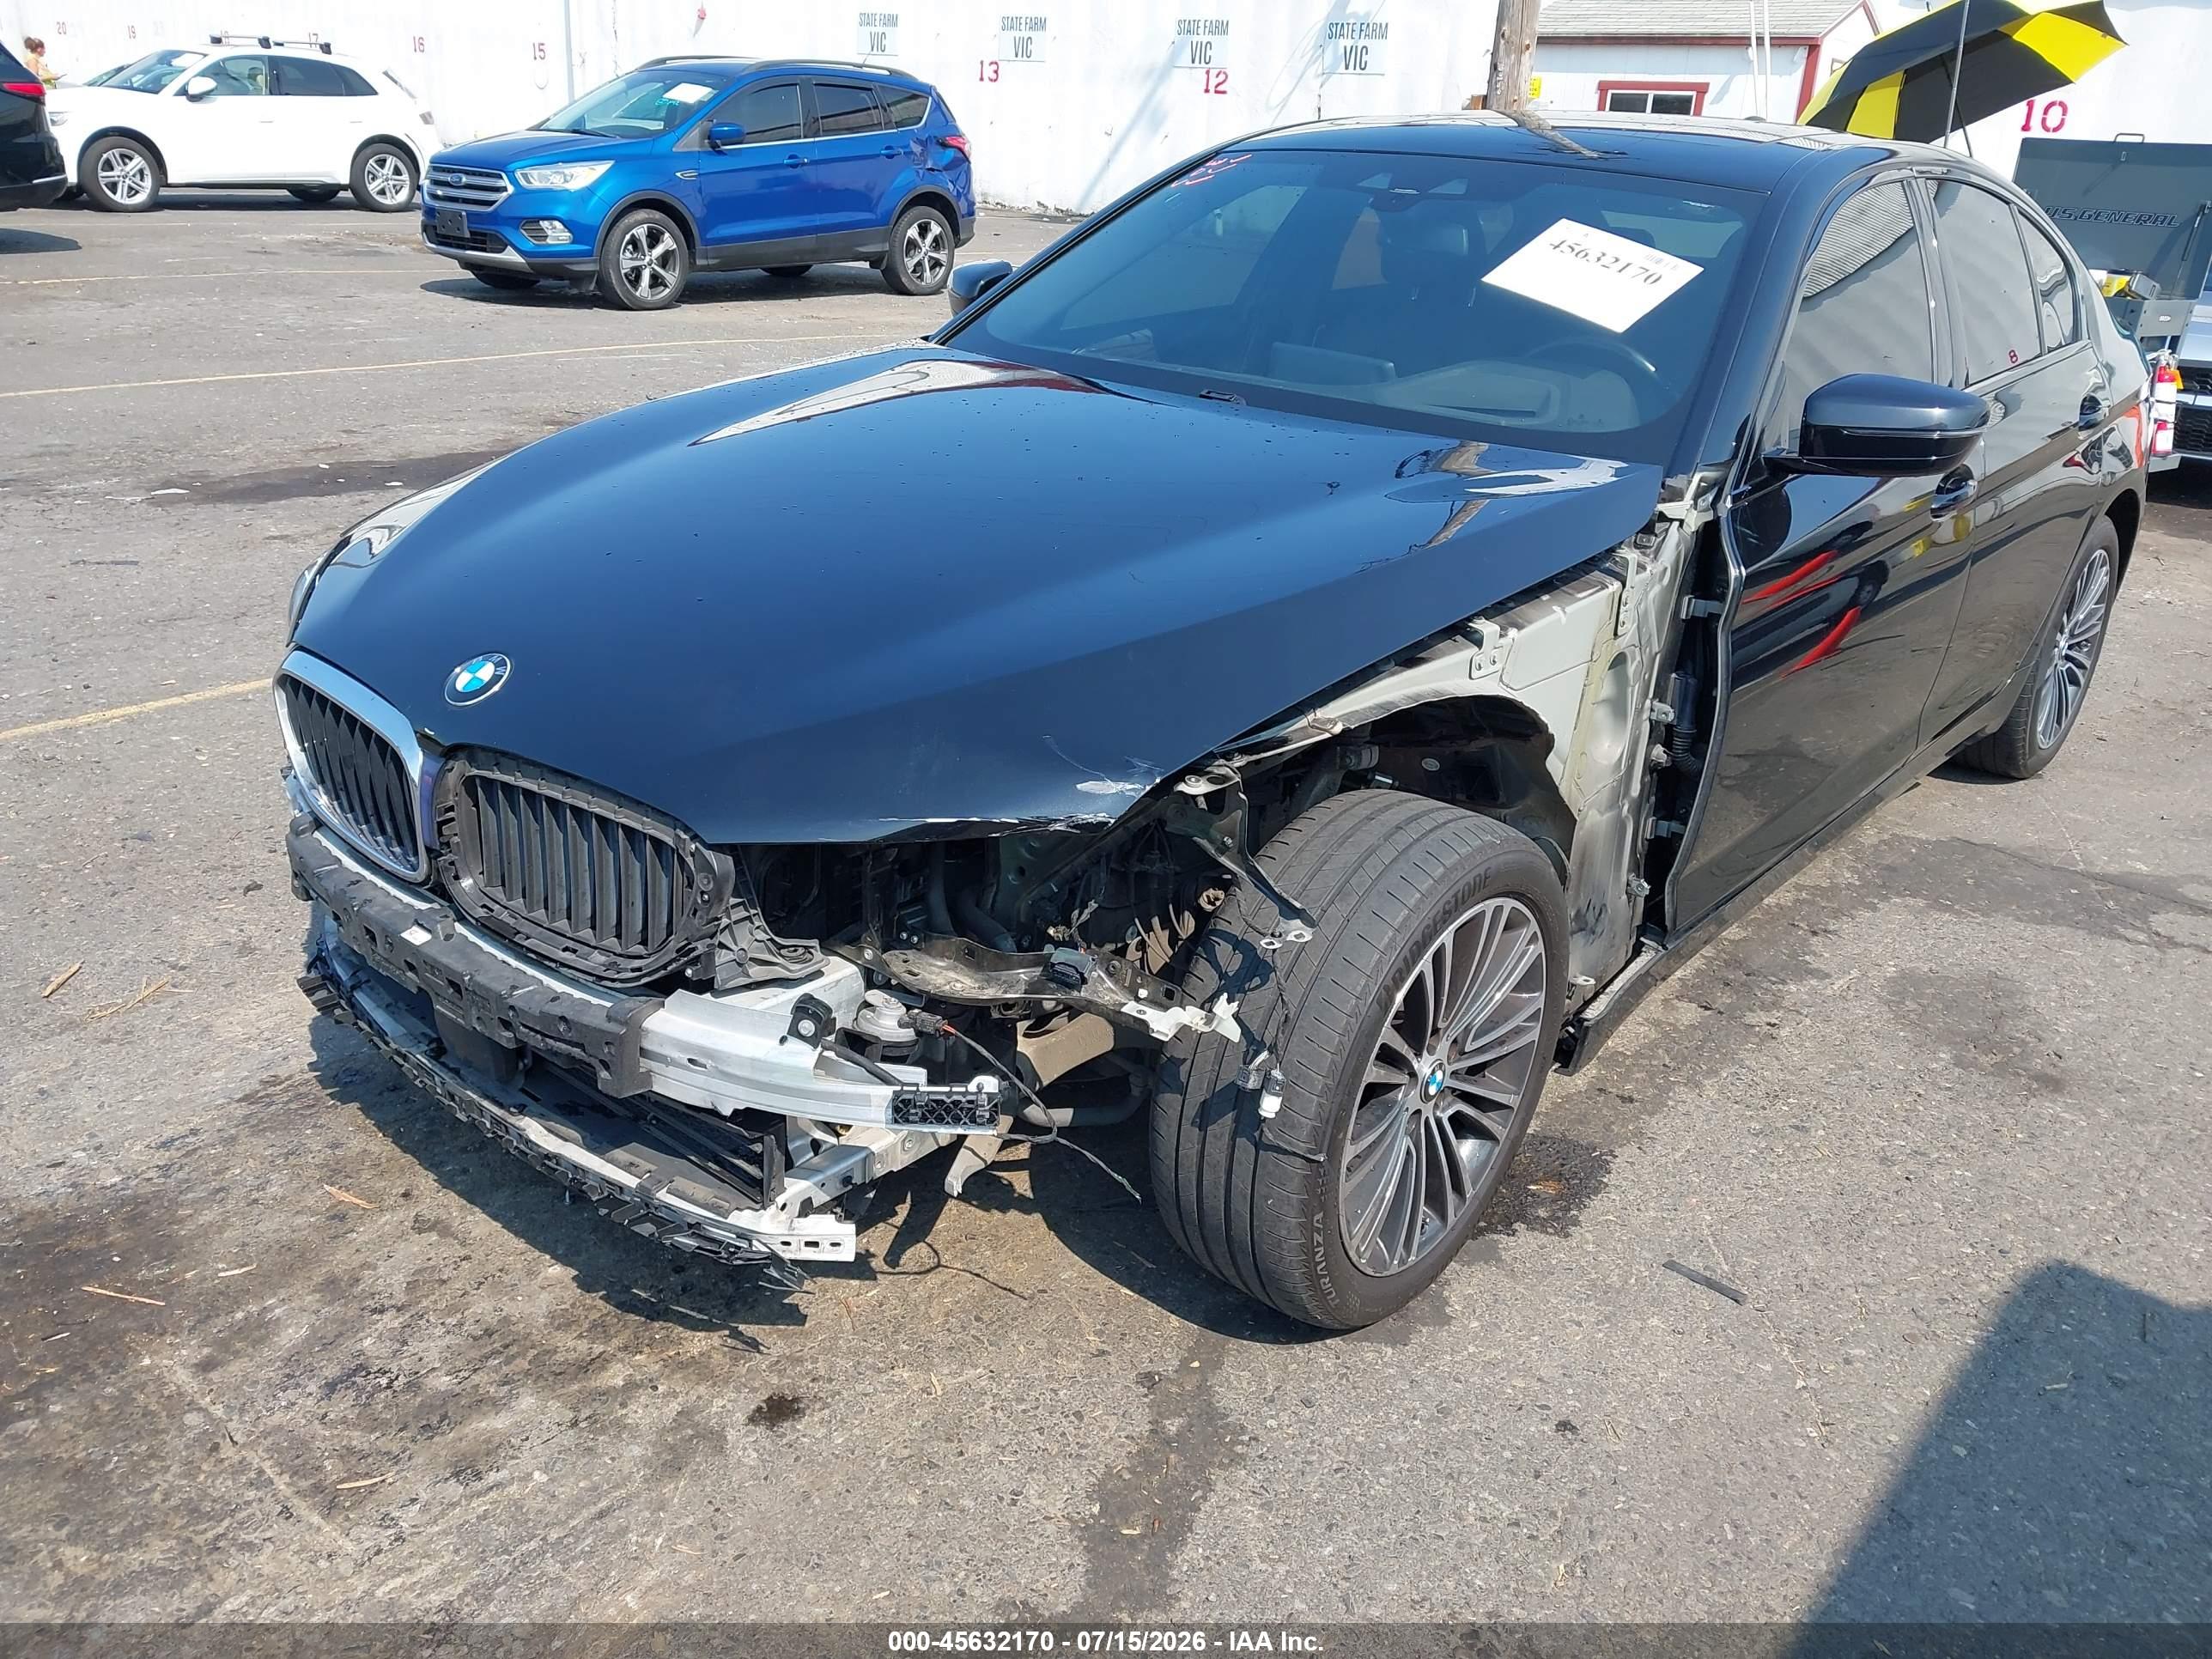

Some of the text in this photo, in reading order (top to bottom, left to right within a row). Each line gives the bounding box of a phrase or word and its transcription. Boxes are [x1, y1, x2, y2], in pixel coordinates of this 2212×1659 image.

[57, 21, 67, 35] 20
[859, 12, 898, 27] STATE FARM
[1001, 16, 1047, 32] STATE FARM
[1177, 19, 1229, 36] STATE FARM
[128, 26, 137, 39] 19
[870, 31, 886, 52] VIC
[1328, 22, 1389, 40] STATE FARM
[413, 36, 425, 53] 16
[532, 42, 546, 60] 15
[1013, 36, 1032, 58] VIC
[1190, 40, 1212, 65] VIC
[1343, 45, 1369, 71] VIC
[978, 59, 1000, 82] 13
[1204, 69, 1229, 94] 12
[2021, 99, 2069, 133] 10
[1549, 239, 1662, 286] 45632170
[1313, 1211, 1340, 1309] TURANZA
